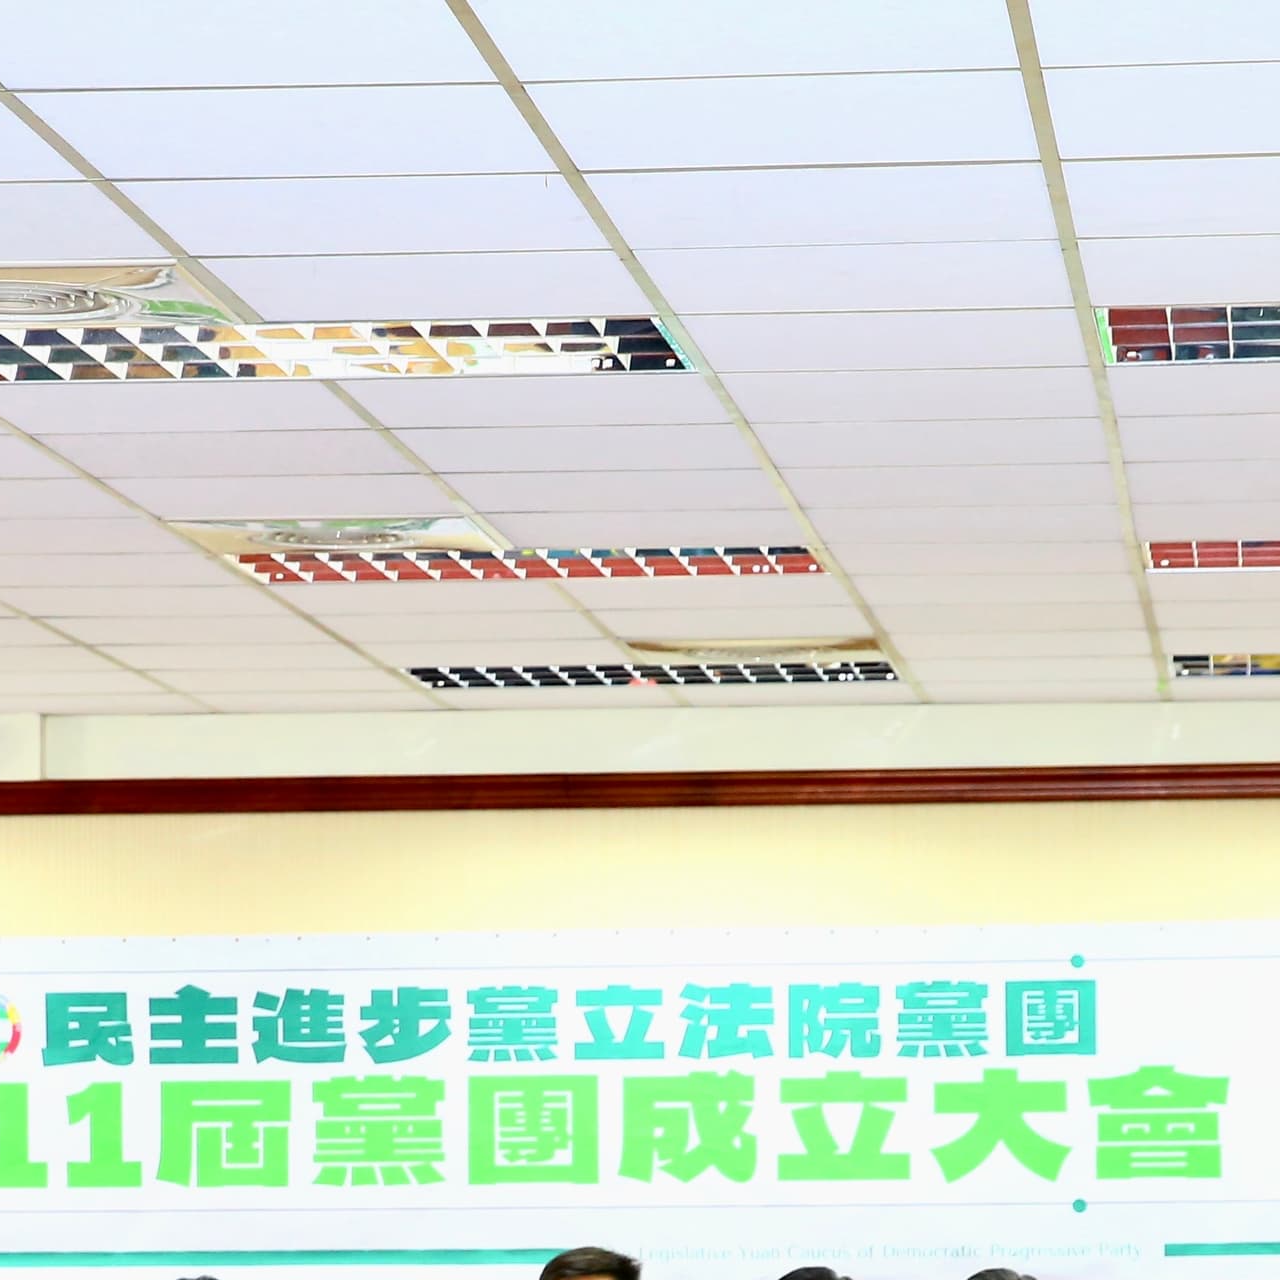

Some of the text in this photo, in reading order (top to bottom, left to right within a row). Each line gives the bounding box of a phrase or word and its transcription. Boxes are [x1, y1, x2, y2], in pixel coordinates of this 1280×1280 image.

[41, 979, 1098, 1068] 民主進步黨立法院黨團
[639, 1245, 732, 1263] Legislative
[738, 1244, 780, 1259] Yuan
[786, 1244, 851, 1259] Caucus
[857, 1243, 875, 1259] of
[882, 1243, 980, 1258] Democratic
[990, 1242, 1091, 1262] Progressive
[1098, 1241, 1143, 1262] Party
